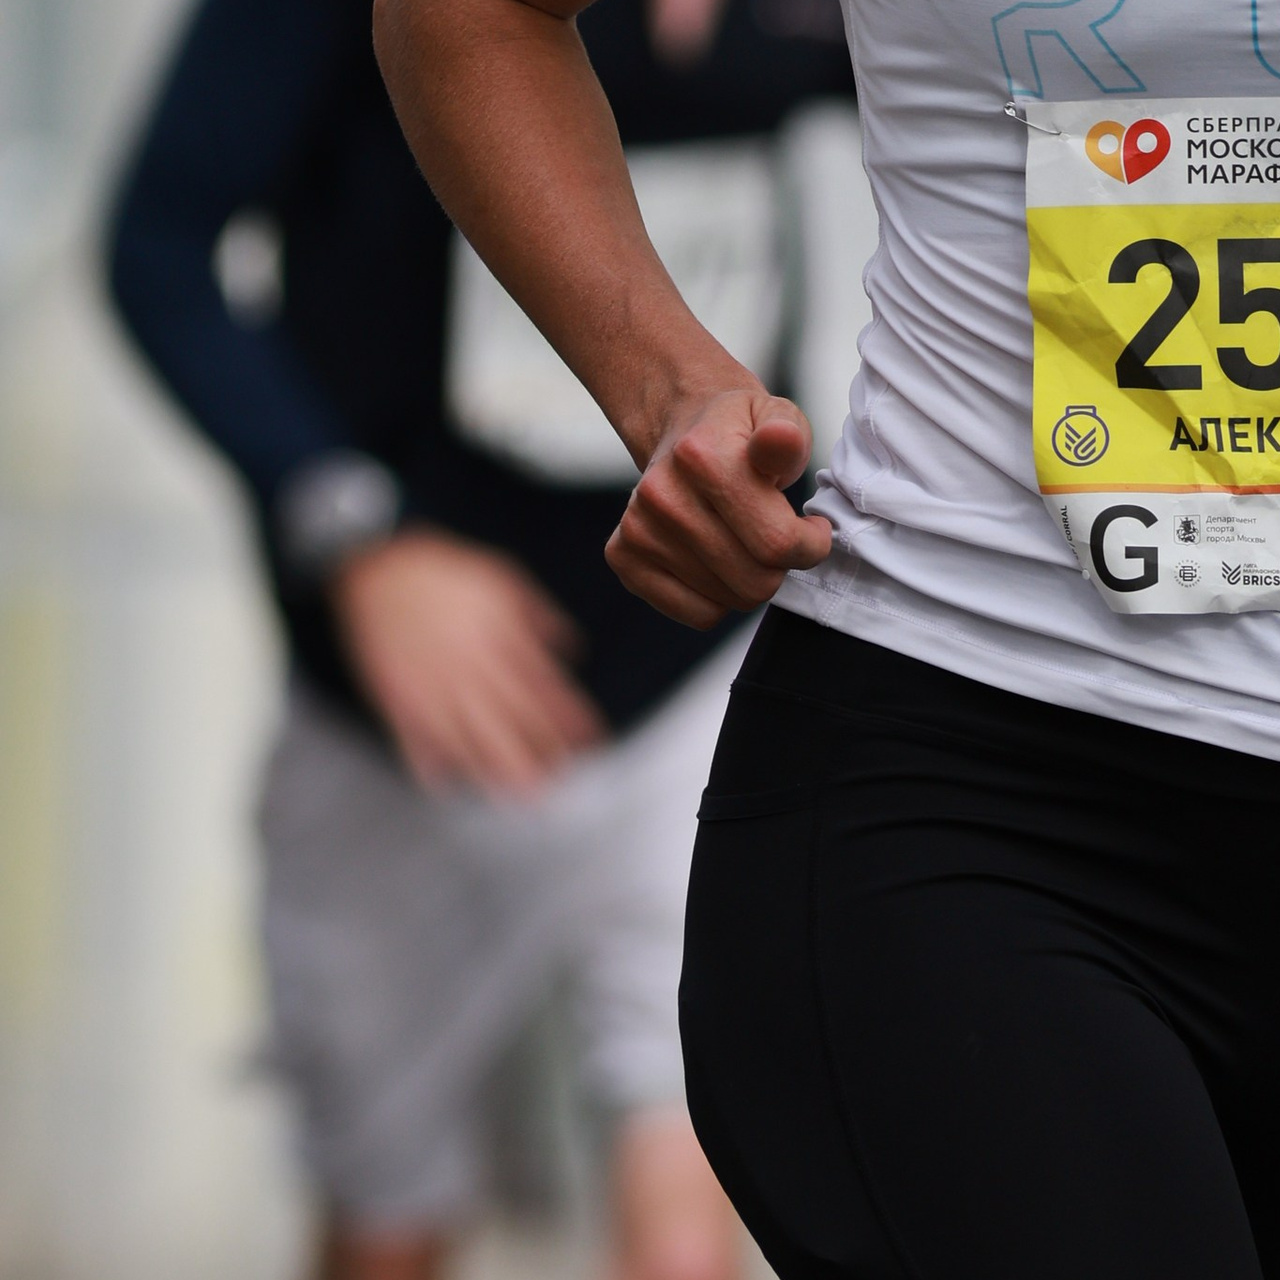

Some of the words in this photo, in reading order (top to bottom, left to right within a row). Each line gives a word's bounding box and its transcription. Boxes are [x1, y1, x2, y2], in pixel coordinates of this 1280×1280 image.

[1206, 526, 1235, 534] спорта
[1206, 535, 1235, 544] города
[1090, 504, 1159, 593] G
[1243, 575, 1280, 586] BRICS
